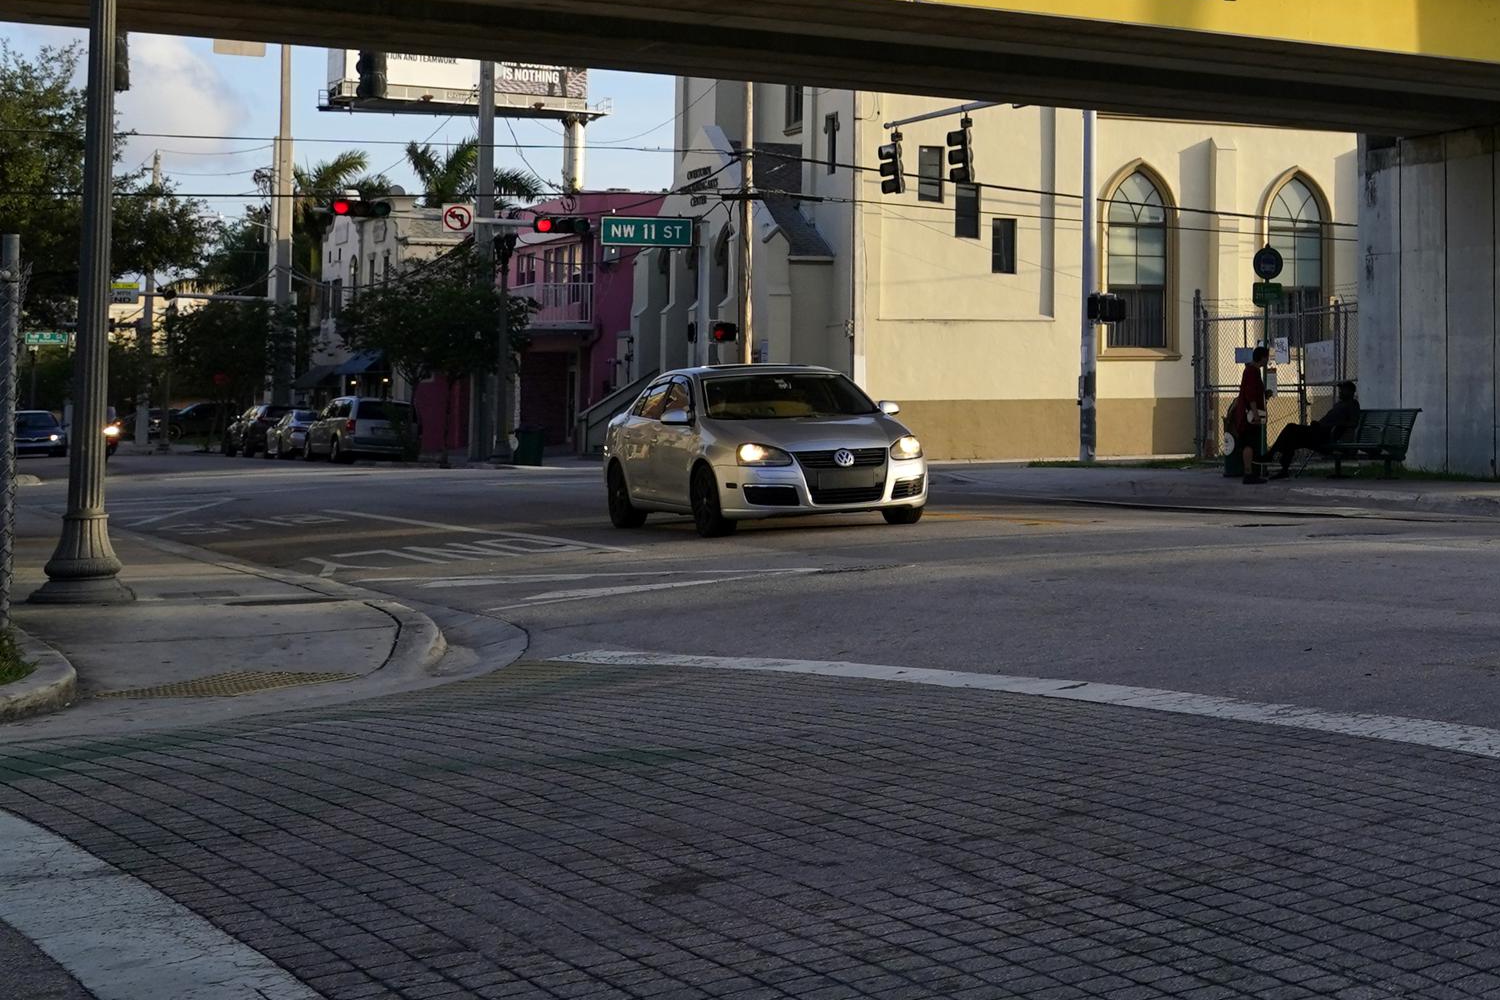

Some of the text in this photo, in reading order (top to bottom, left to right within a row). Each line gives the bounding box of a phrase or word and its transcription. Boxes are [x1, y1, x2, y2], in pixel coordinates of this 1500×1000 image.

[503, 67, 560, 83] IS NOTHING
[611, 223, 683, 240] NW 11 ST
